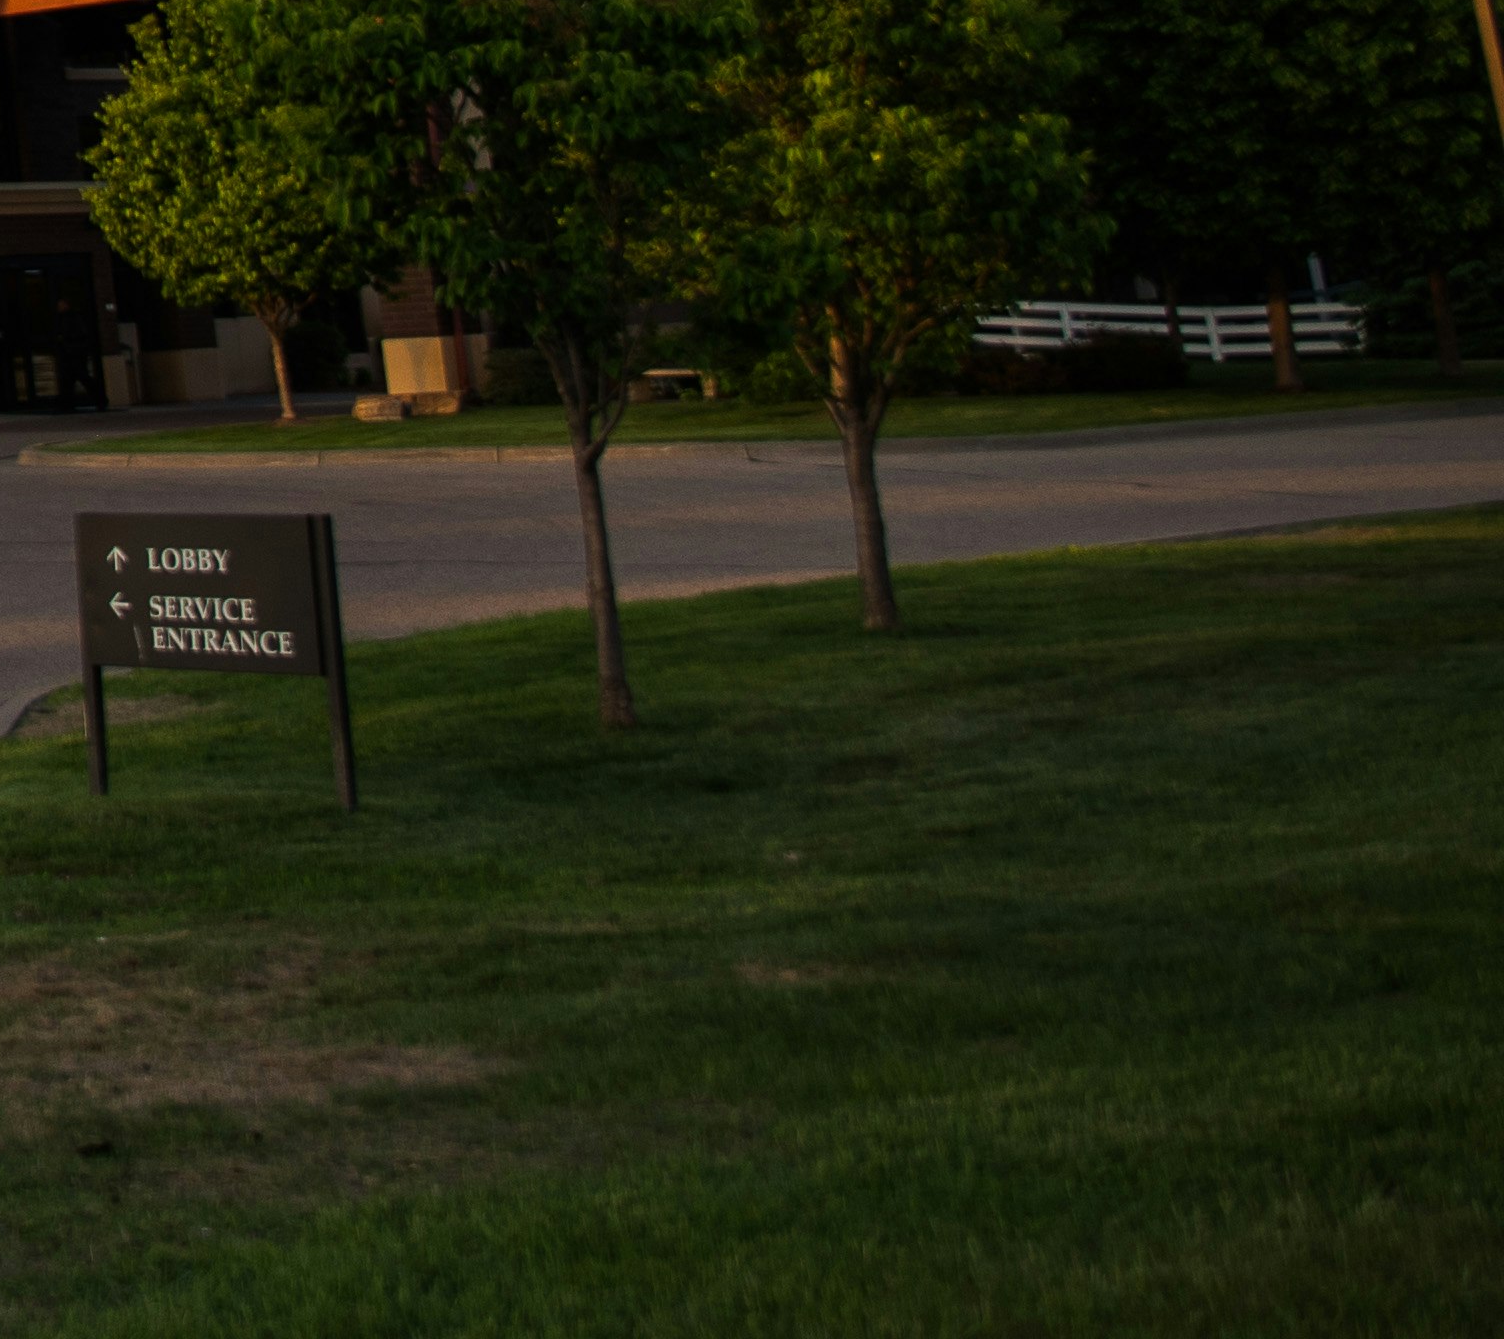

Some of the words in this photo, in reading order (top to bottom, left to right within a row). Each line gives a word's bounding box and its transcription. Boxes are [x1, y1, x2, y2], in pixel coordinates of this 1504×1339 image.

[146, 546, 231, 574] LOBBY
[149, 595, 257, 624] SERVICE
[151, 626, 297, 657] ENTRANCE
